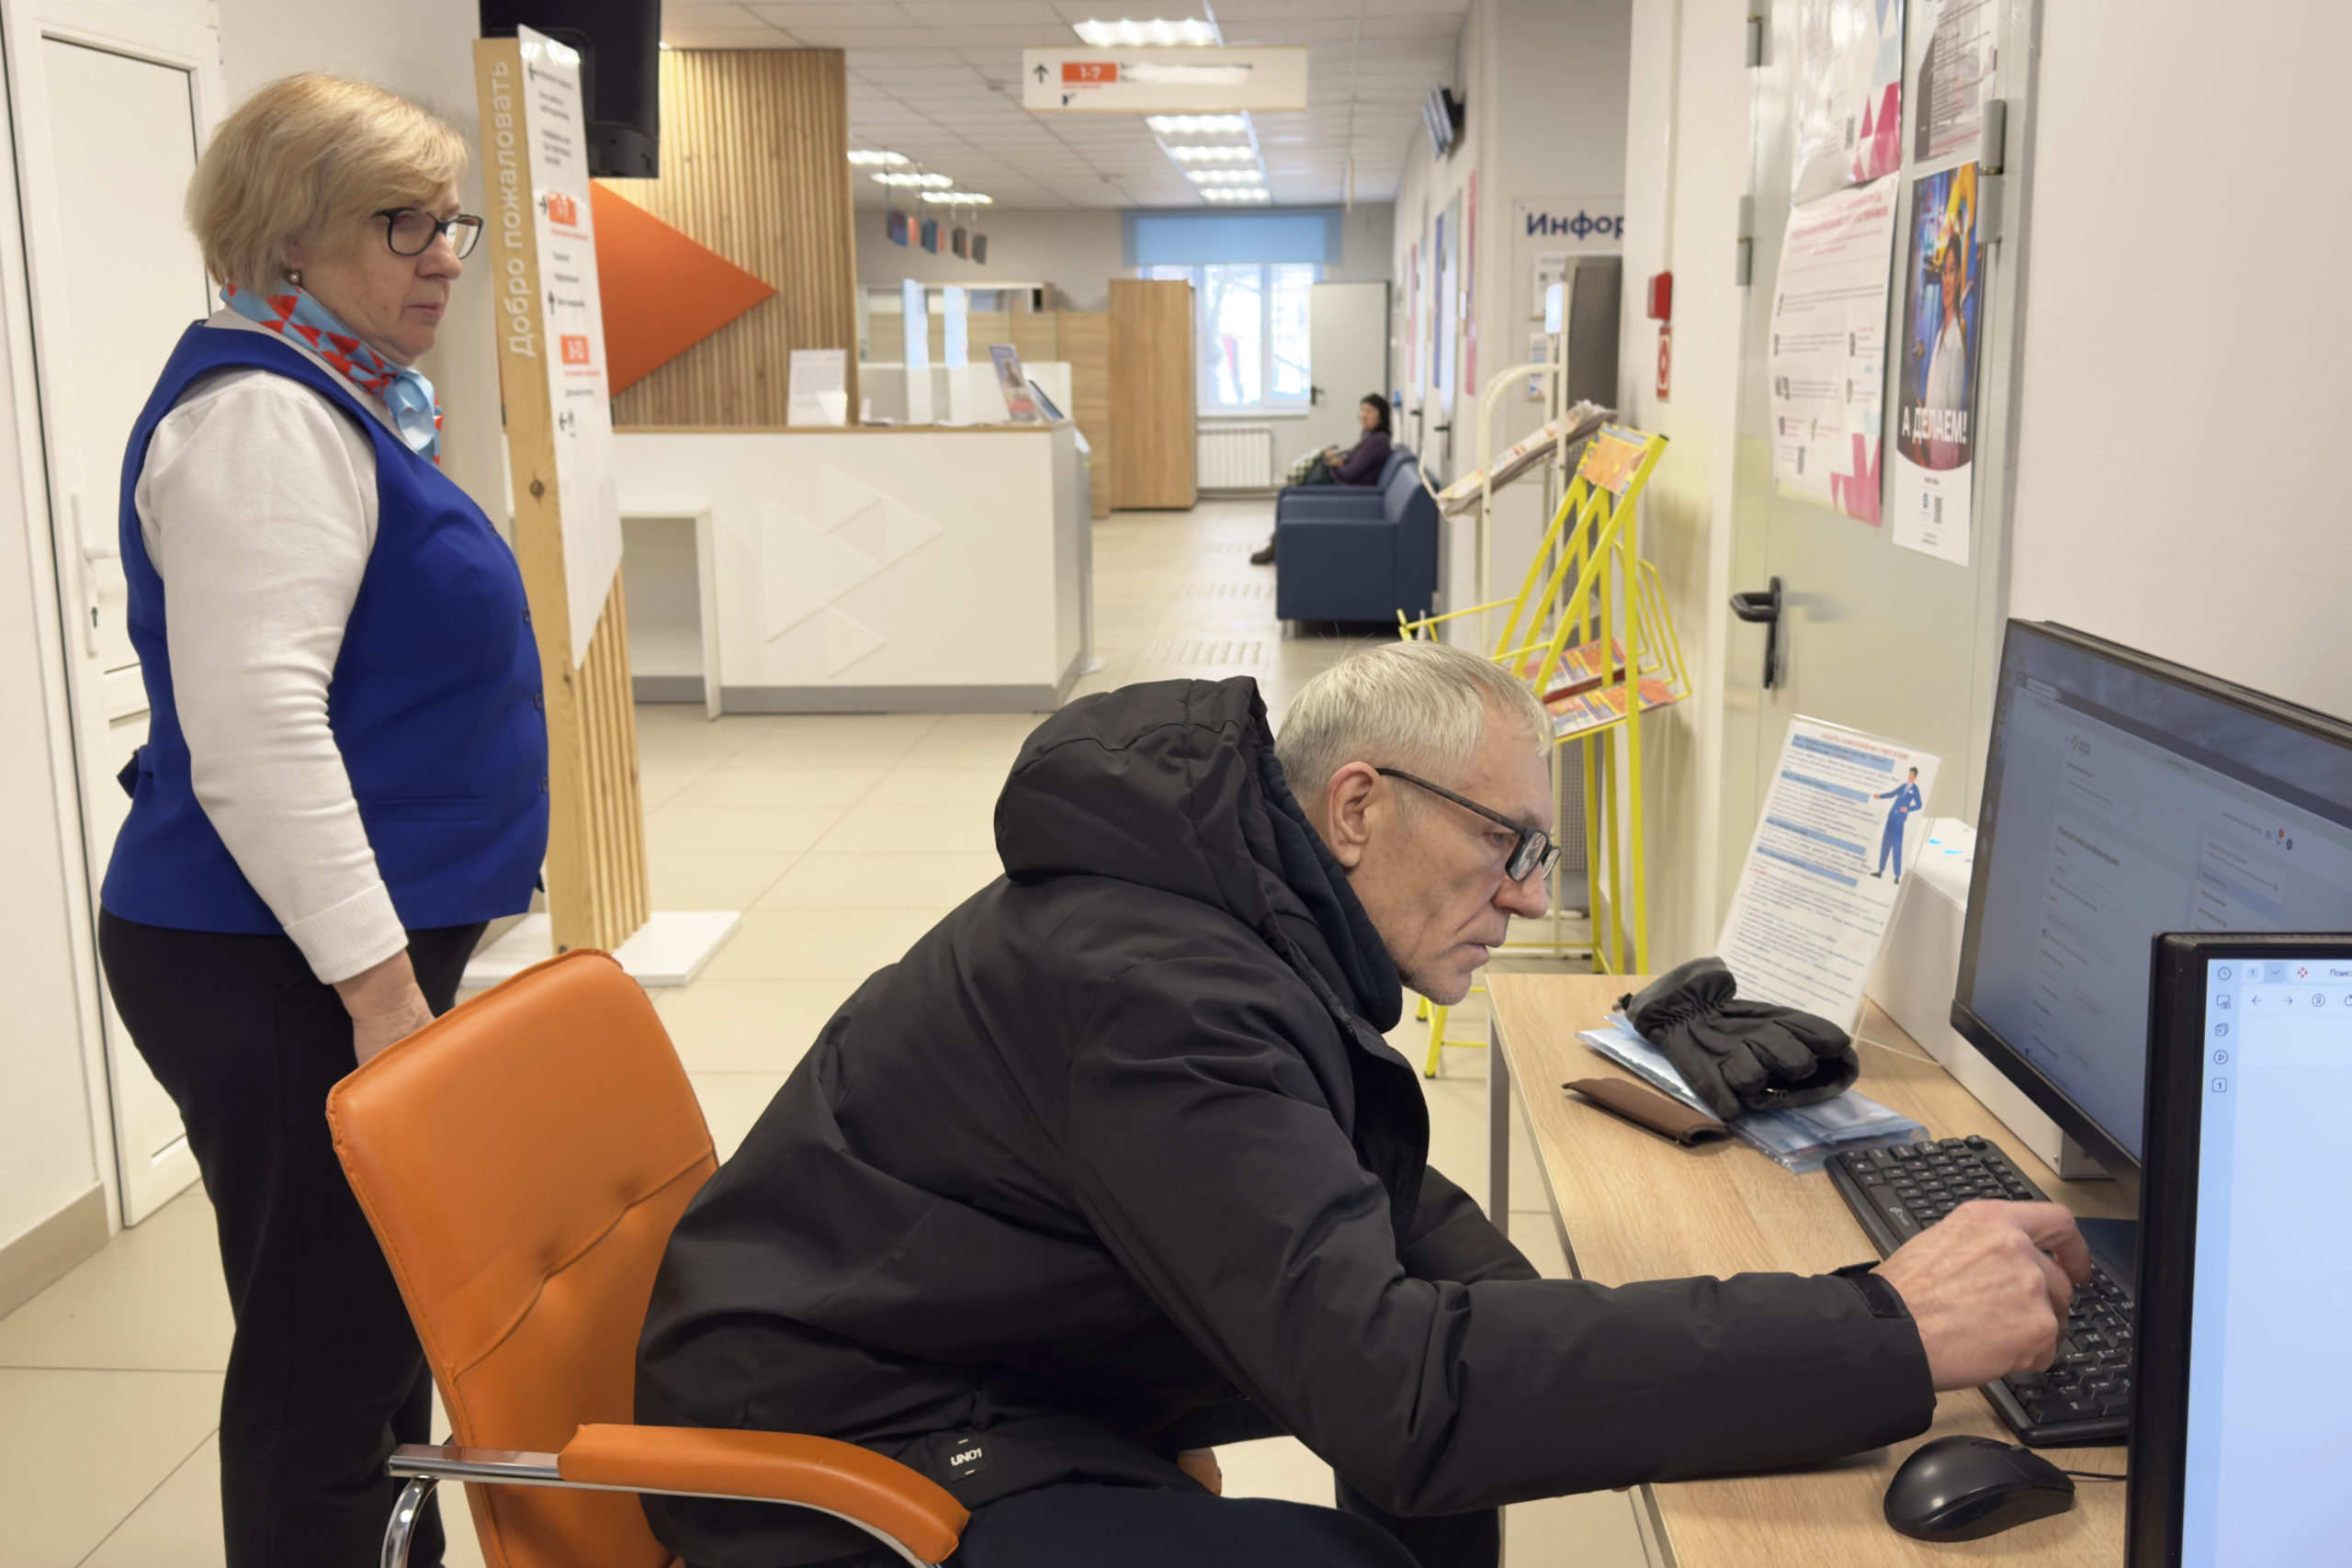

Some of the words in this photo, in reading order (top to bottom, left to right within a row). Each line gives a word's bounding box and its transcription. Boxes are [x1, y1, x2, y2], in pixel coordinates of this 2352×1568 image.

[491, 61, 523, 248] пожаловать
[503, 257, 537, 358] Добро
[1902, 406, 1910, 436] А
[1912, 407, 1967, 445] ДЕЛАЕМ!
[950, 1447, 982, 1466] UNO1
